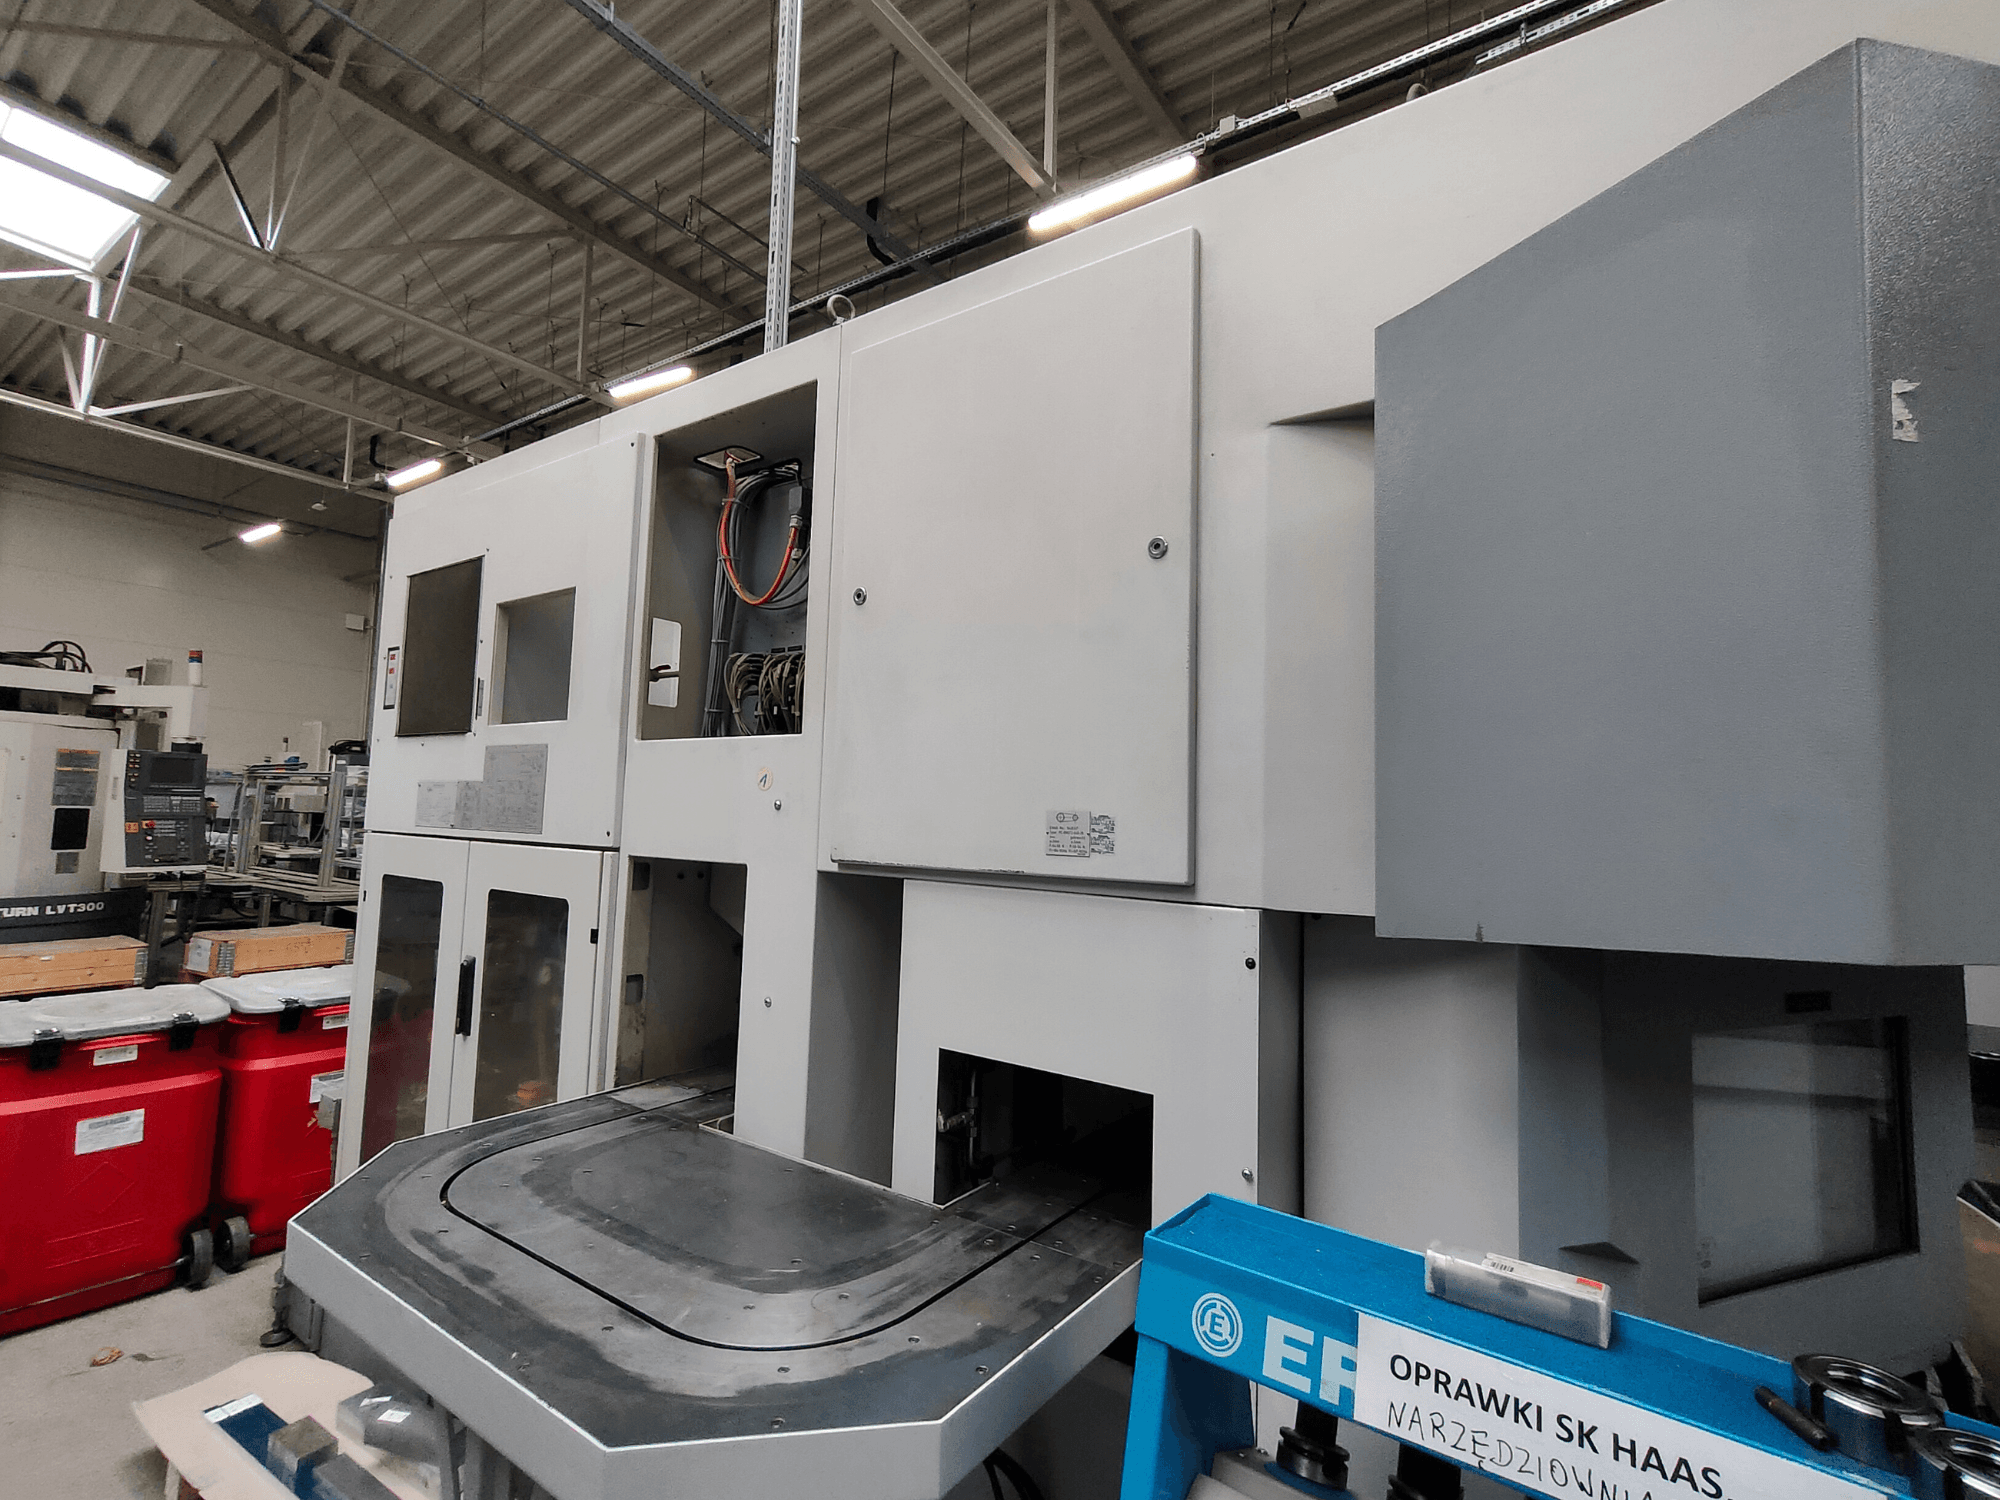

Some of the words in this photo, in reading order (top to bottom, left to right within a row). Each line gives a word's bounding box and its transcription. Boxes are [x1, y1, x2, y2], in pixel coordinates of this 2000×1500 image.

[45, 901, 105, 916] LVT300
[1390, 1354, 1543, 1433] OPRAWKI
[1555, 1413, 1599, 1455] SK
[1612, 1432, 1724, 1499] HAAS
